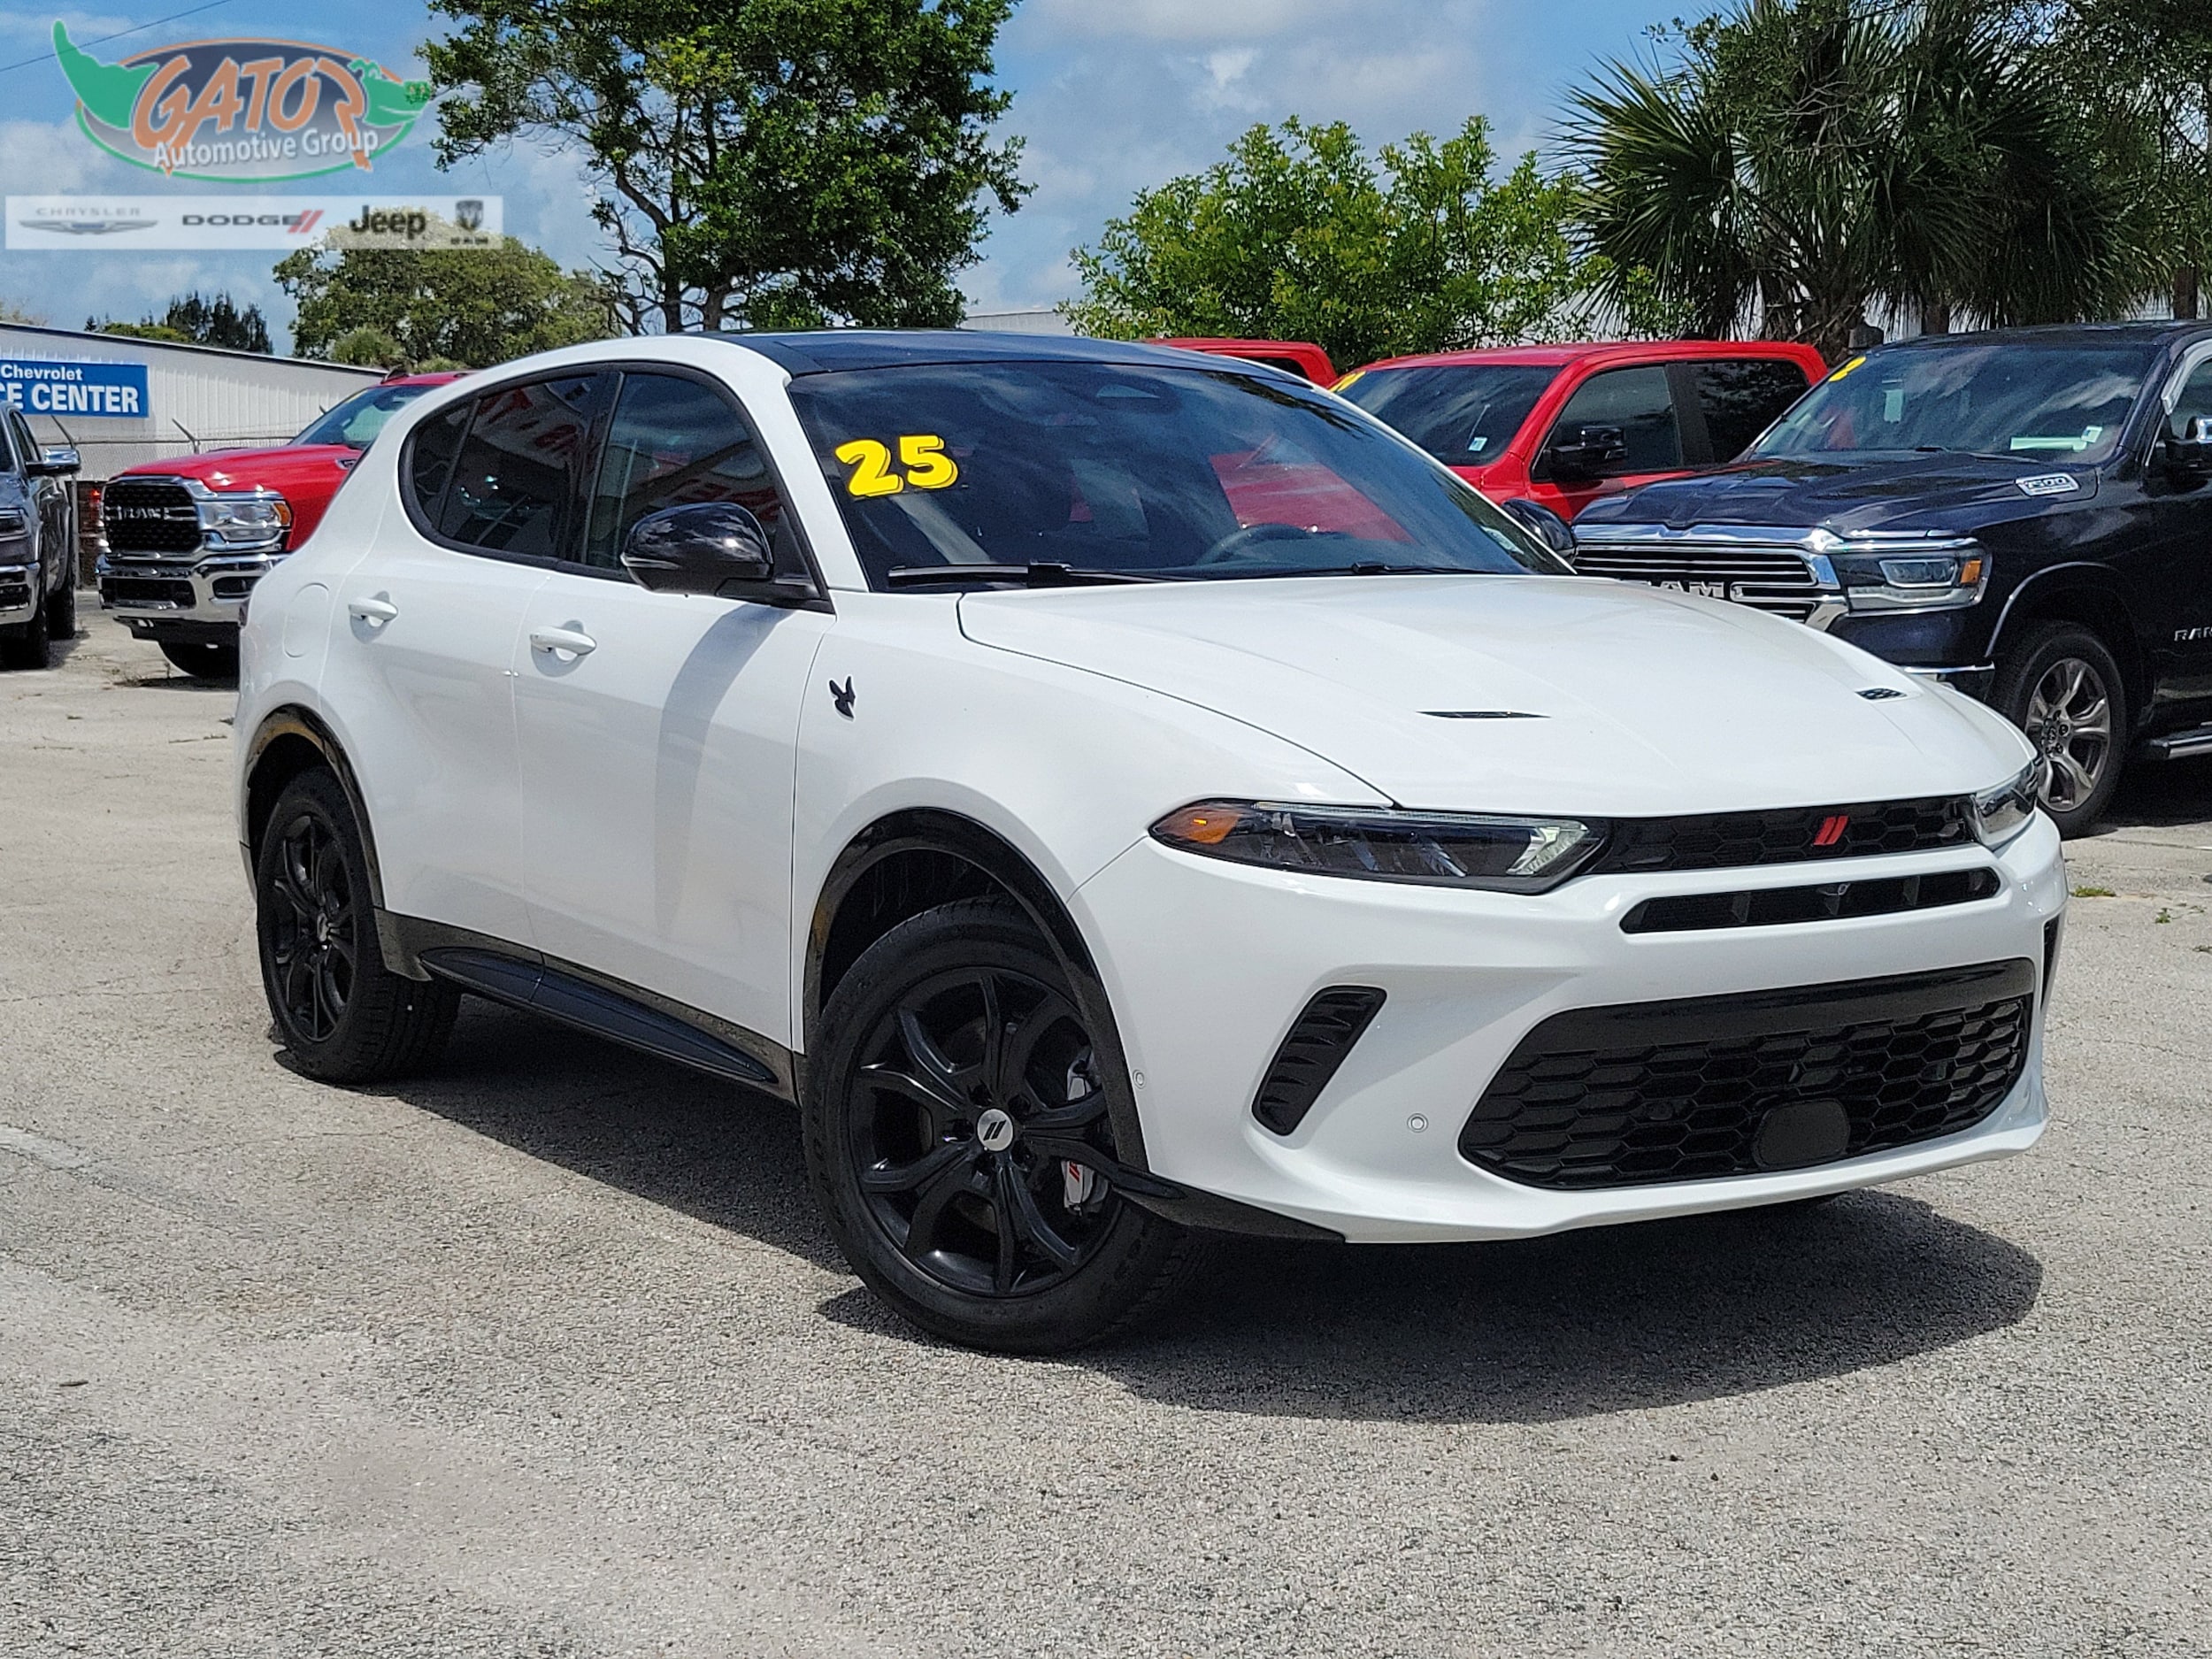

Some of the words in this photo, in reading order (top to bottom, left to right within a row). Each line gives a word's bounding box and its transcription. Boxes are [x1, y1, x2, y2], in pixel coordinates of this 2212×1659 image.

[1, 365, 83, 380] Chevrolet
[0, 382, 24, 410] E
[31, 383, 139, 413] CENTER
[835, 434, 958, 497] 25
[1647, 580, 1724, 599] AM
